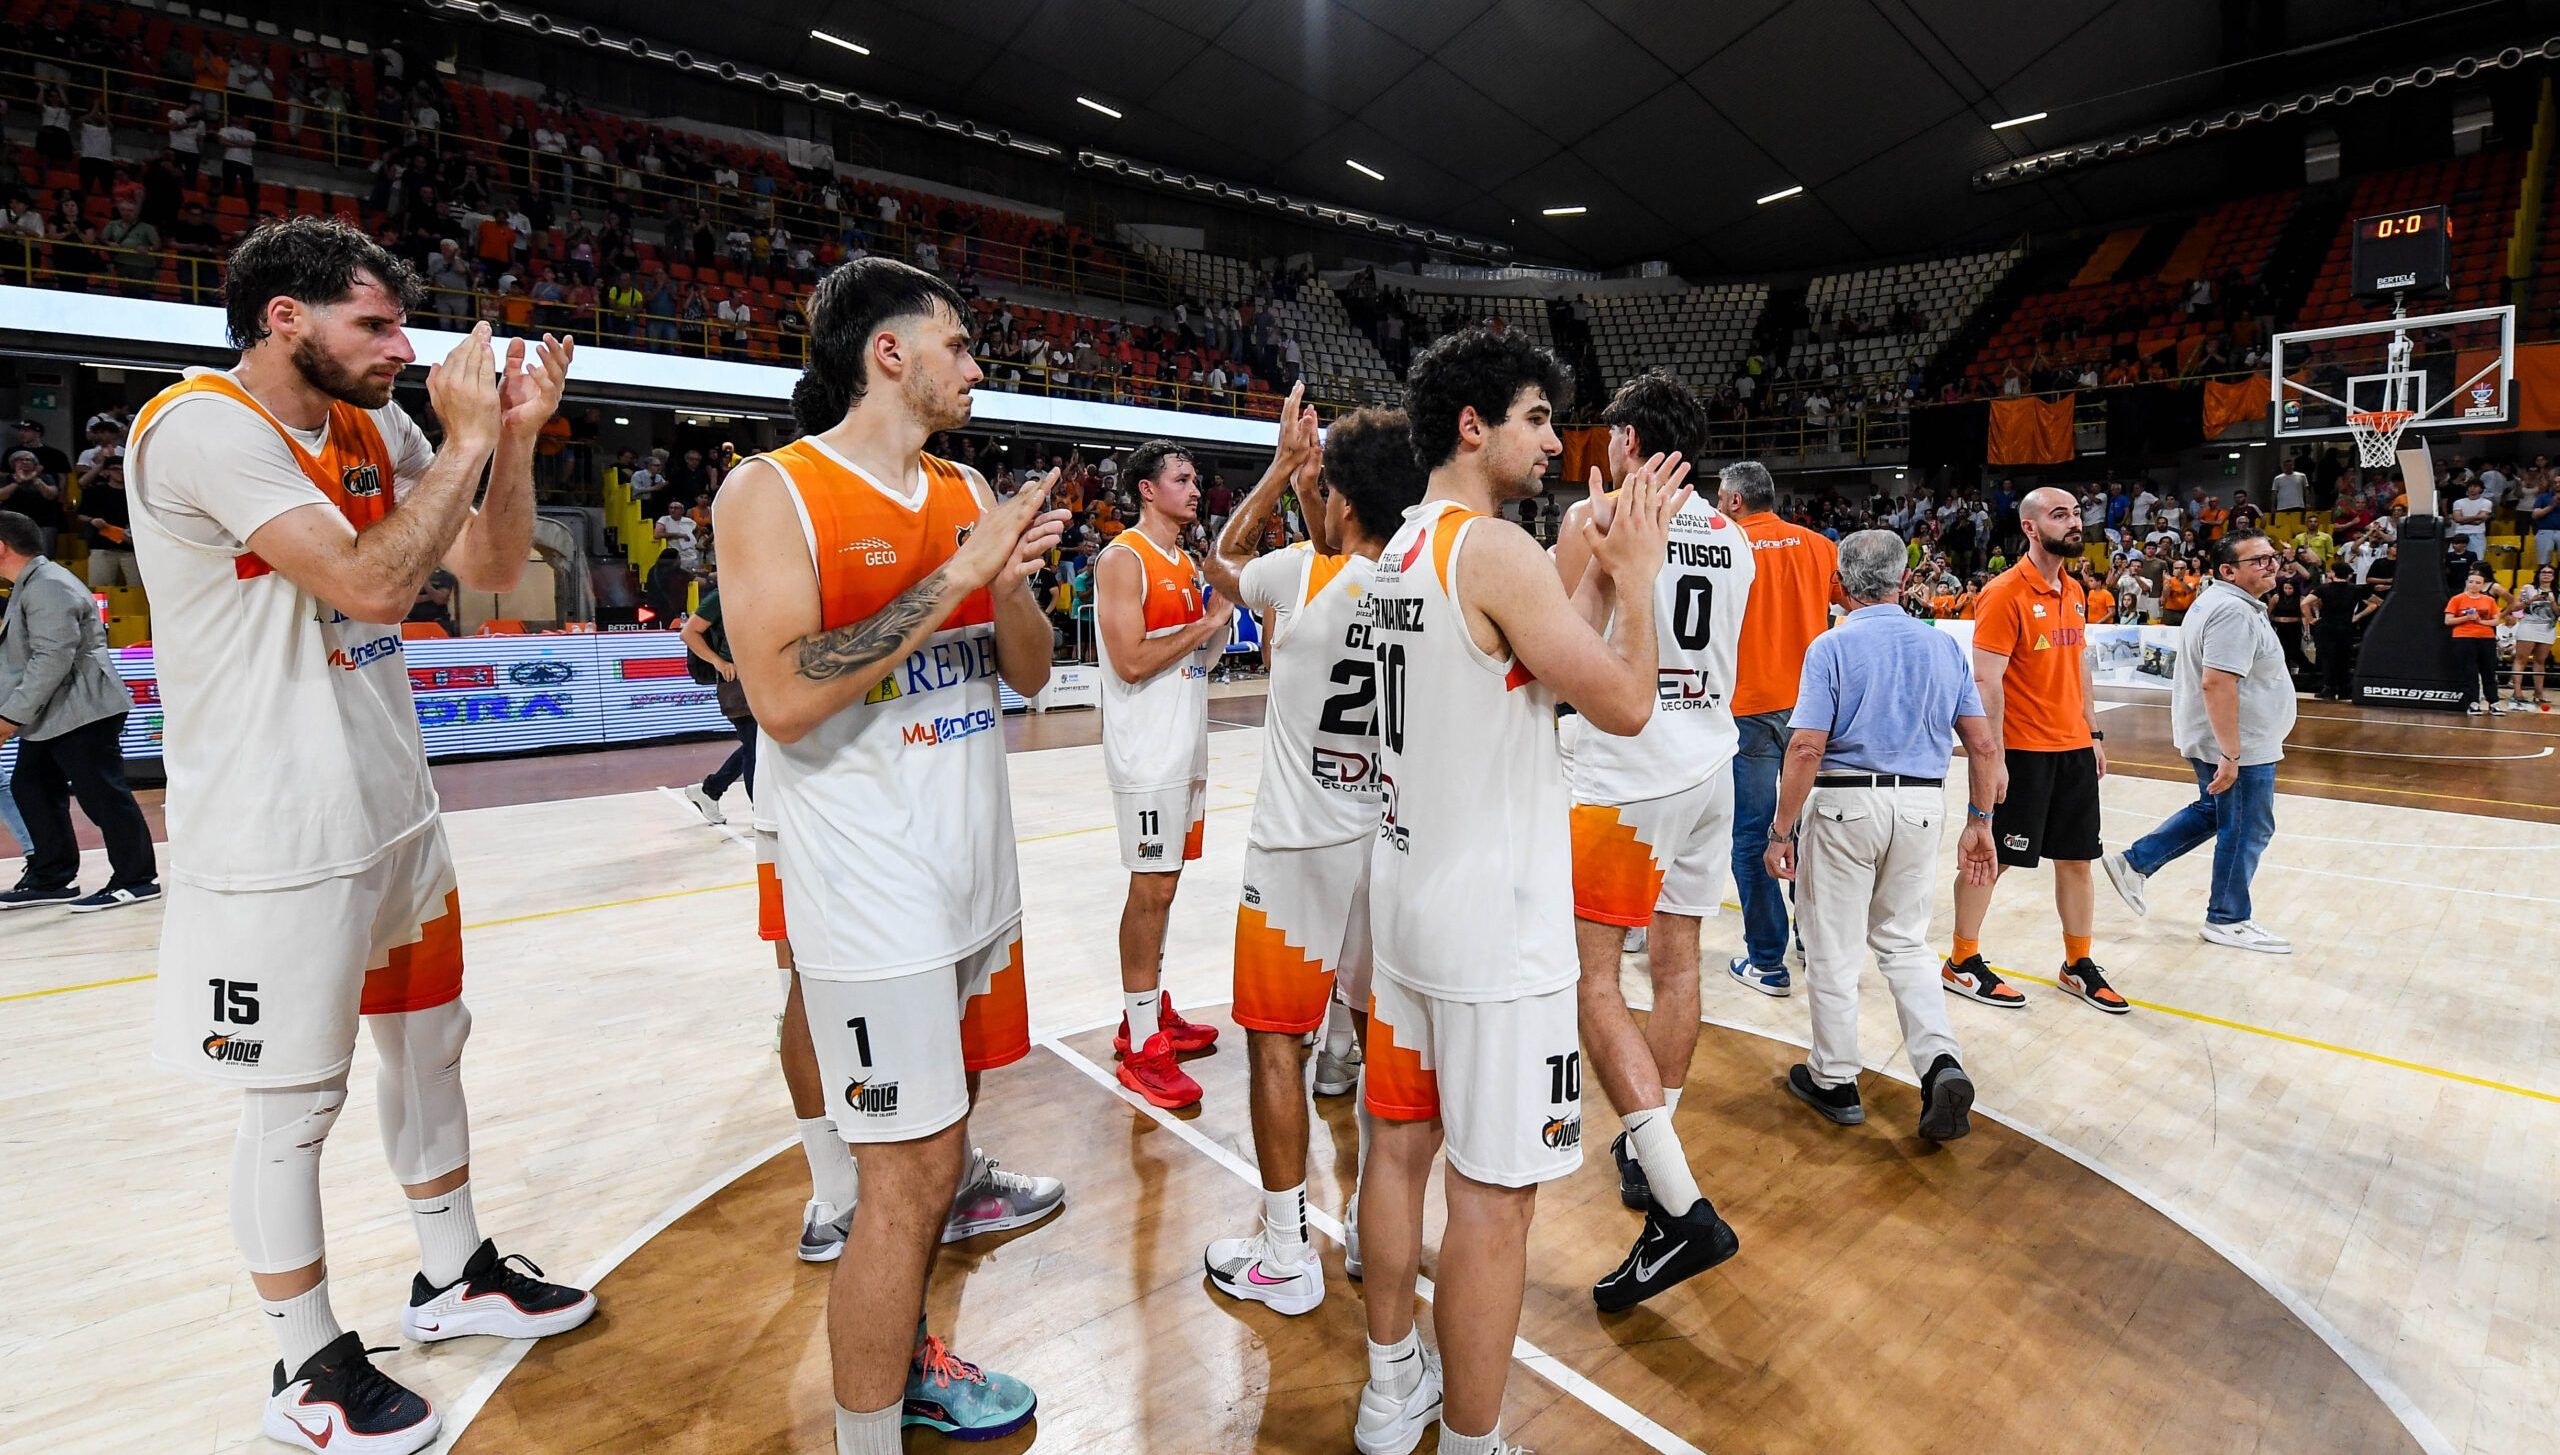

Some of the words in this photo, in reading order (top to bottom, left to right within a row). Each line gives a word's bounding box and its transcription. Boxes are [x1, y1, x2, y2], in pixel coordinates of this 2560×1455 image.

[2378, 214, 2421, 238] 0:0
[1676, 519, 1710, 529] BUFALA
[1667, 540, 1732, 569] FIUSCO
[1750, 537, 1801, 551] yEnergy
[865, 551, 897, 566] GECO
[1673, 574, 1713, 651] 0
[1376, 641, 1406, 758] 10
[2363, 686, 2464, 703] SPORTSYSTEM
[1138, 810, 1159, 836] 11
[208, 978, 260, 1026] 15
[217, 1040, 263, 1064] VIOLA
[846, 1016, 873, 1068] 1
[1546, 1050, 1581, 1105] 10
[860, 1085, 898, 1113] VIOLA
